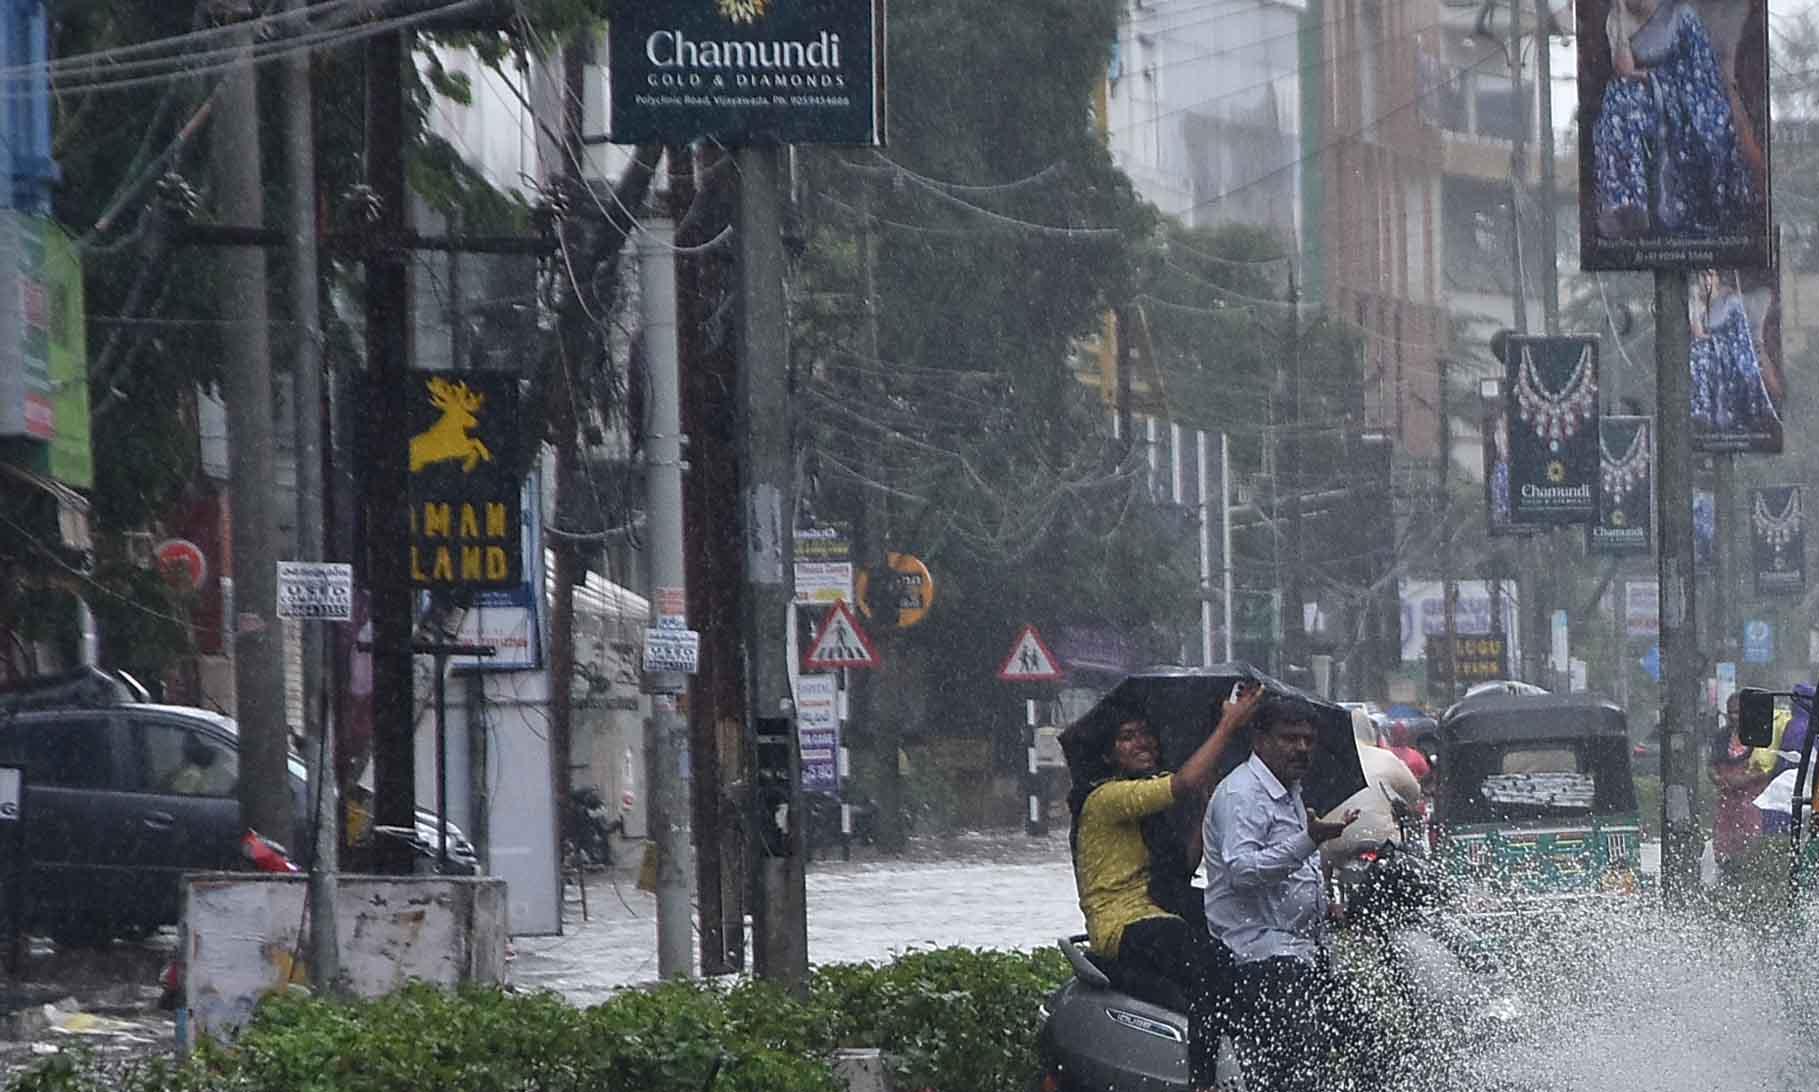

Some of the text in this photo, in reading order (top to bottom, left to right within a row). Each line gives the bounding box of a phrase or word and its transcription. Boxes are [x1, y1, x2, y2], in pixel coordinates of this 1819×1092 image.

[646, 30, 840, 69] Chamundi
[648, 74, 846, 87] GOLD & DIAMONDS
[1521, 484, 1590, 498] Chamundi
[411, 501, 507, 538] MAN
[1592, 526, 1644, 537] Chamundi
